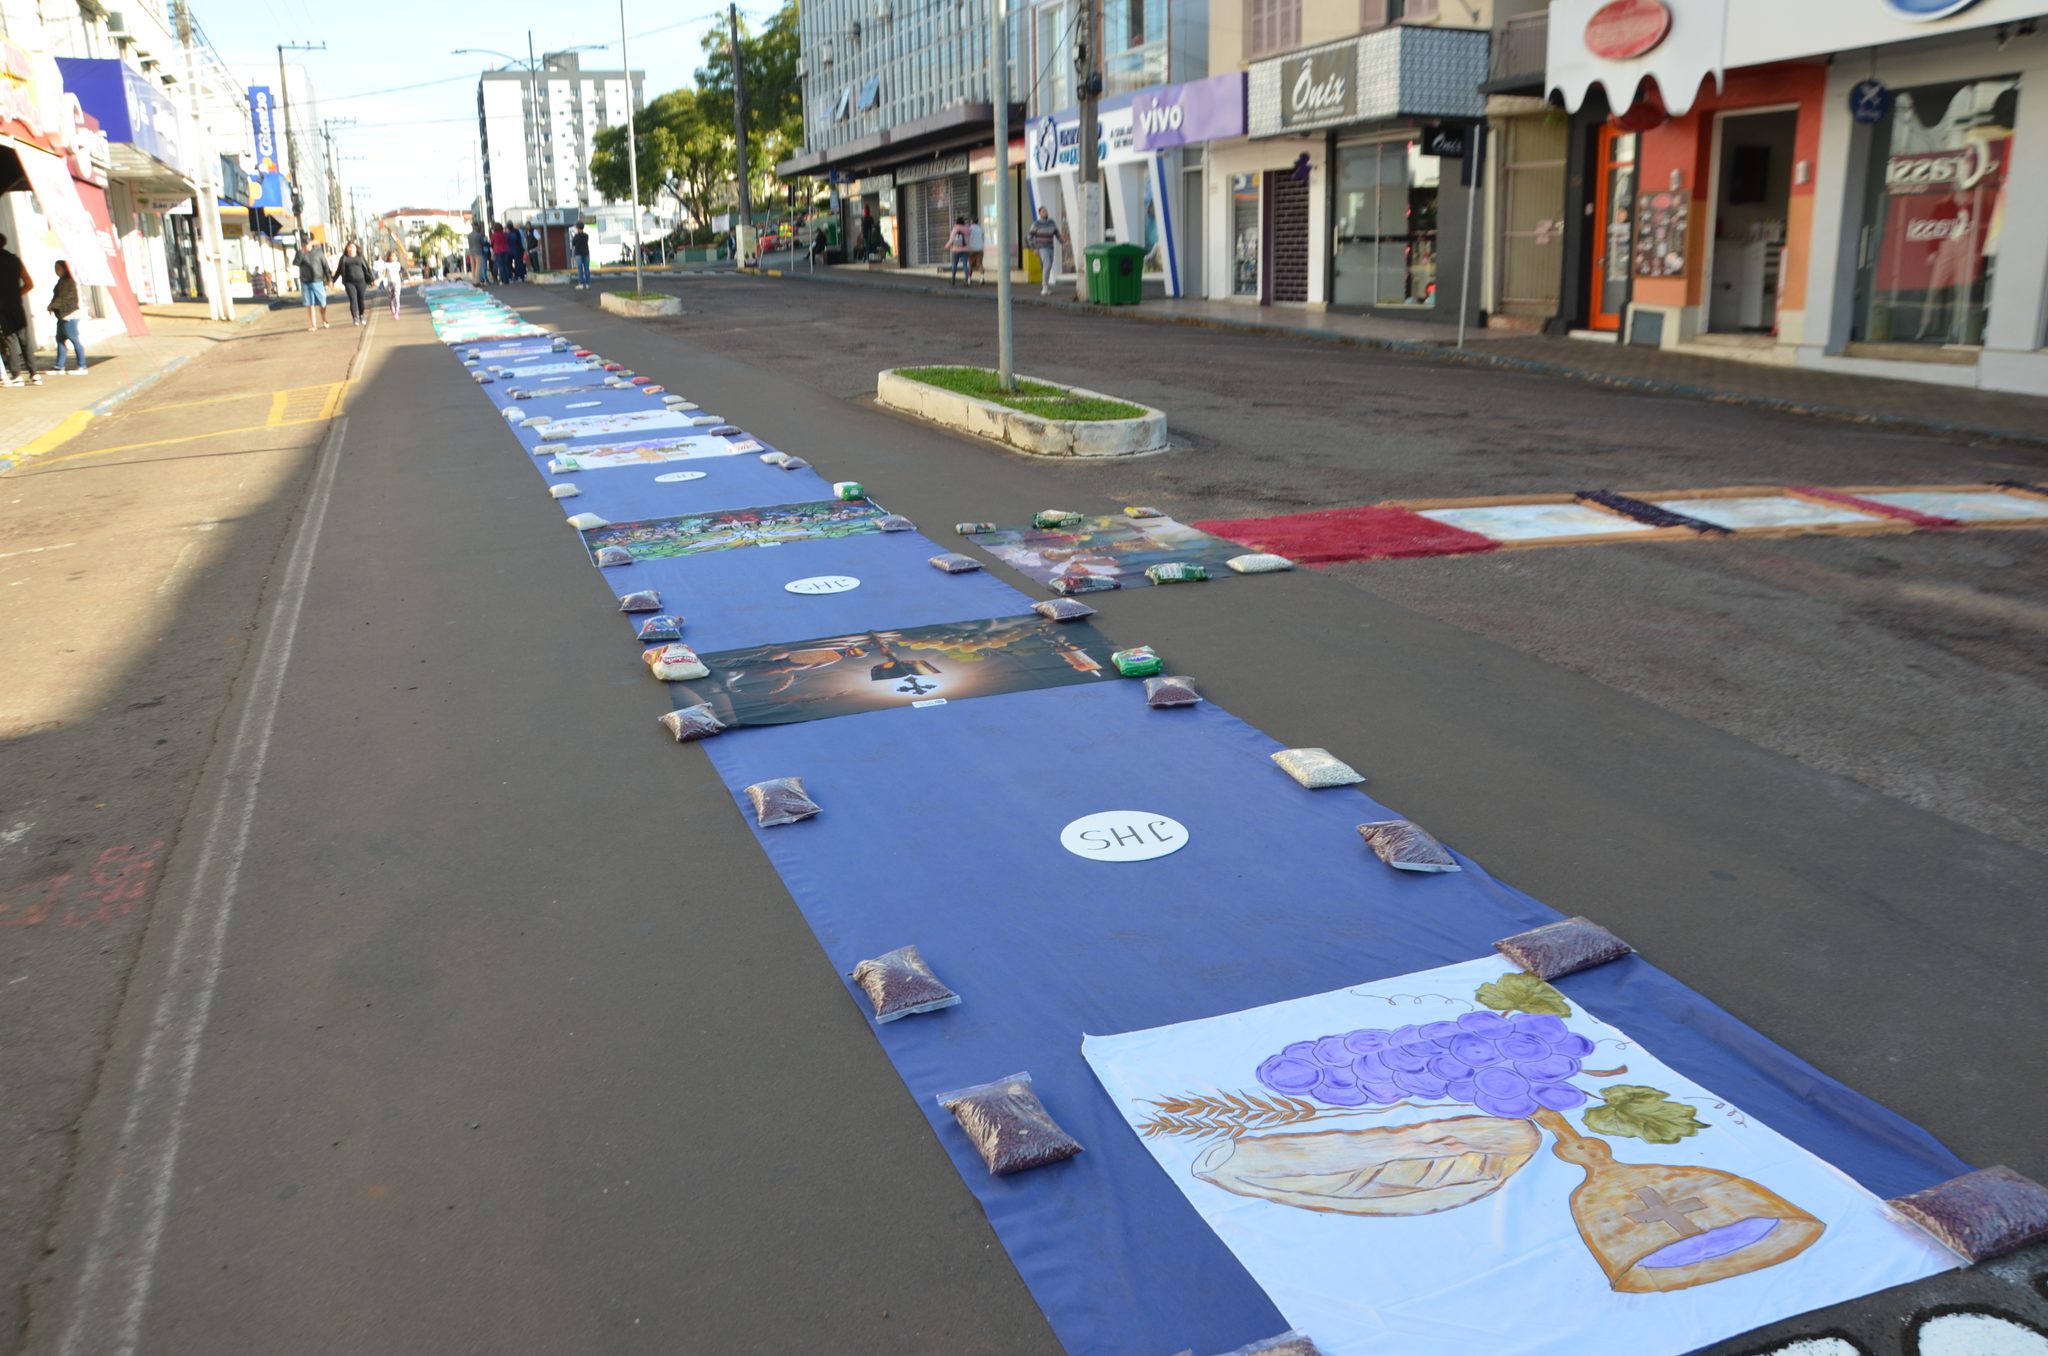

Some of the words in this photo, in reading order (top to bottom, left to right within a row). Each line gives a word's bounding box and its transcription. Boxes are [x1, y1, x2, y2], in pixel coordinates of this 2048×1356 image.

[1292, 57, 1346, 112] Ônix
[256, 92, 273, 157] Colombo
[1140, 97, 1183, 136] vivo
